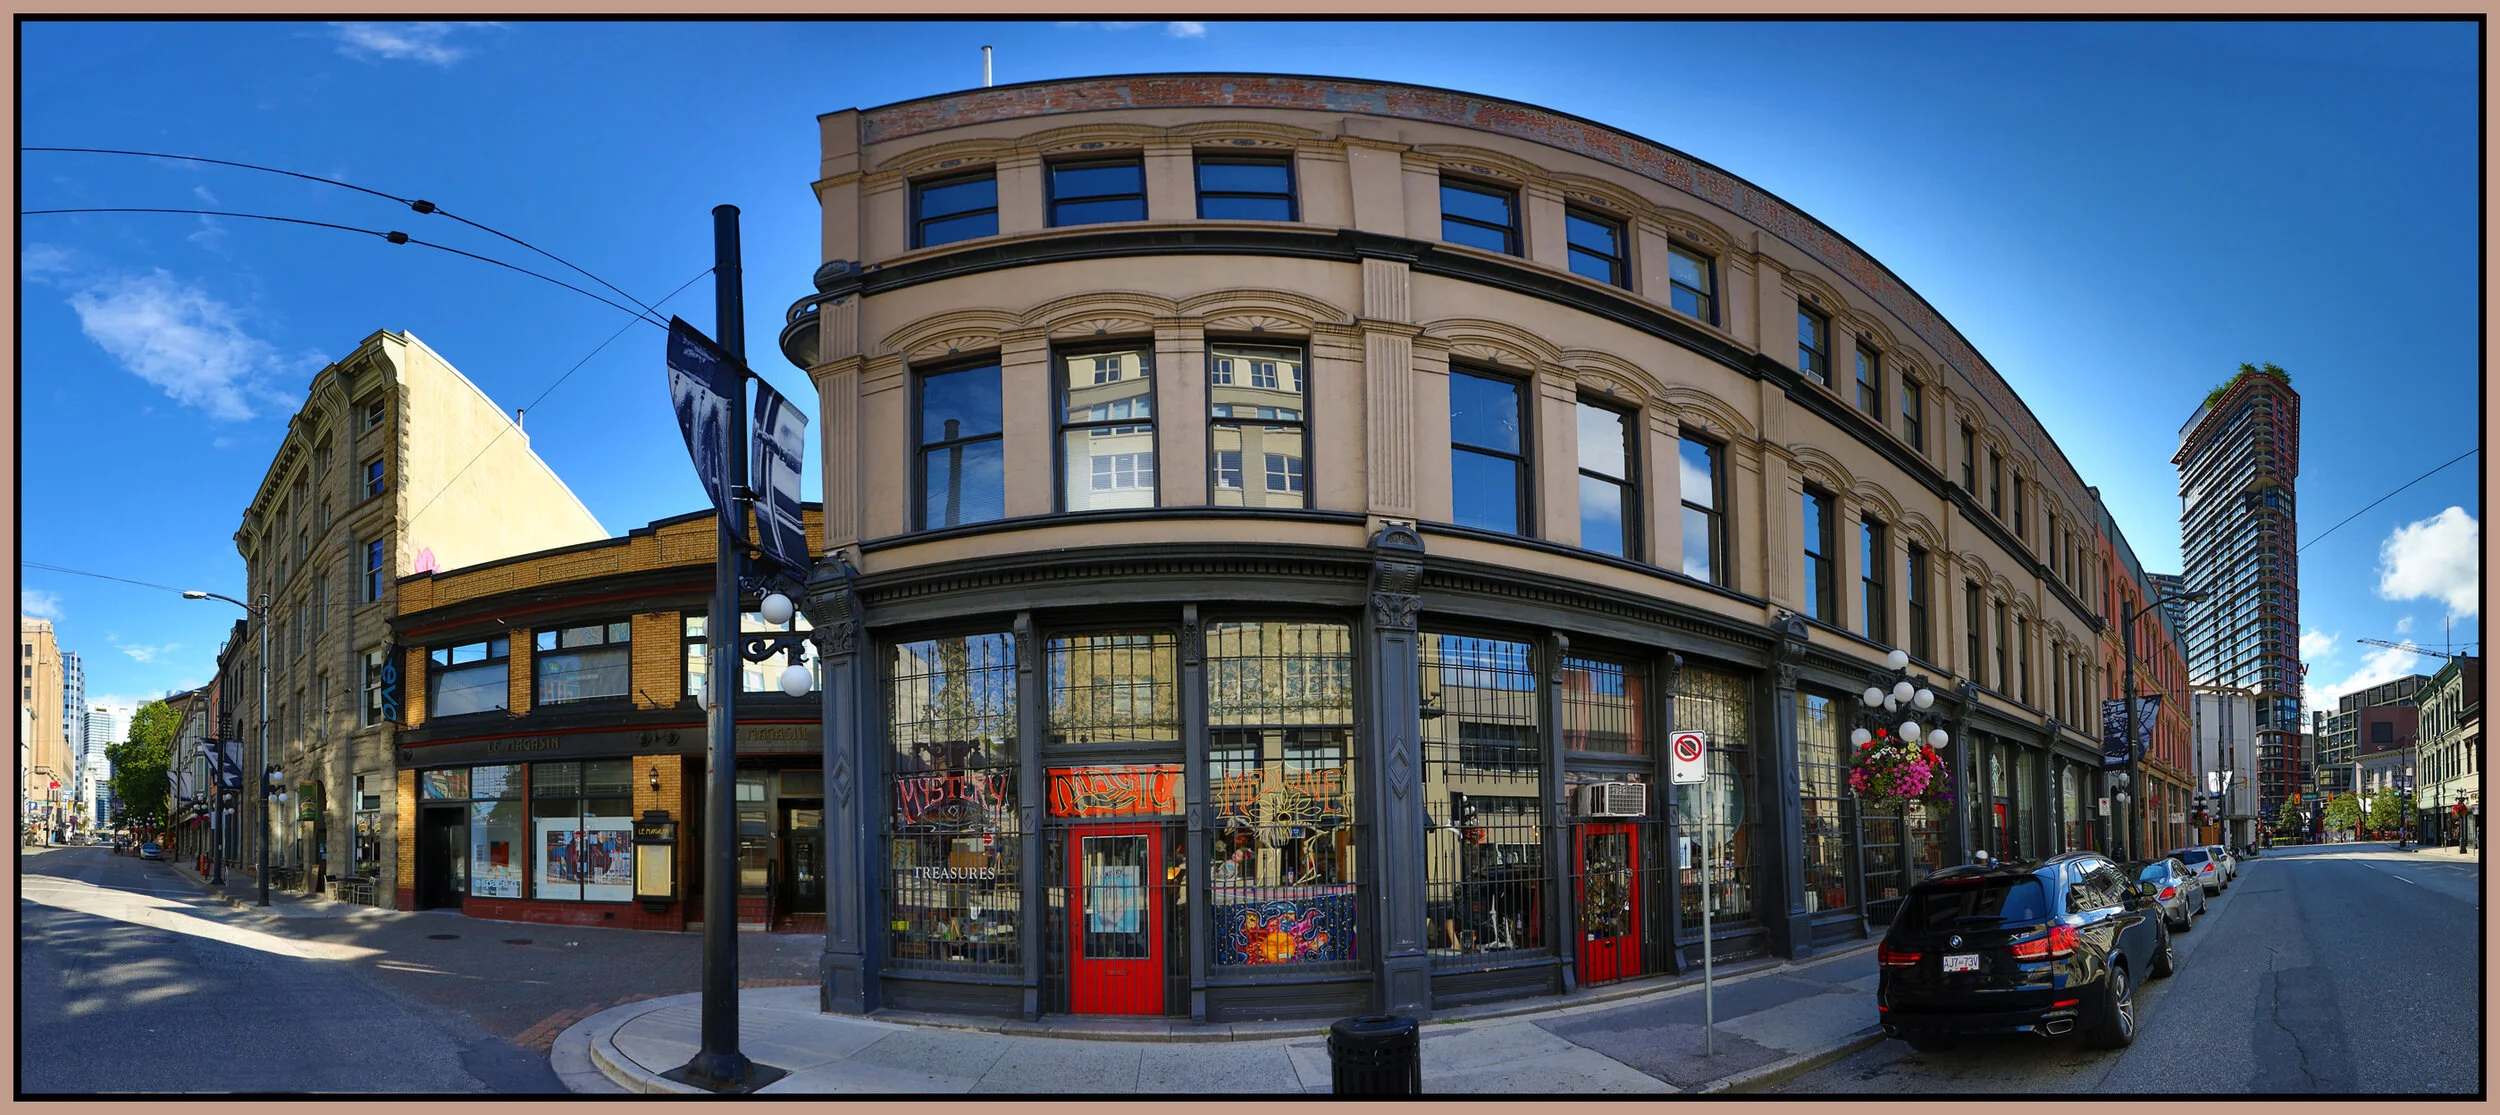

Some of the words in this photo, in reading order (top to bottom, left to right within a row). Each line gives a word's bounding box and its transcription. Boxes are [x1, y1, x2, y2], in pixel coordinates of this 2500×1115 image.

[381, 657, 399, 721] evo
[487, 741, 500, 753] LE
[506, 737, 559, 752] MAGASIN
[746, 727, 808, 741] MAGASIN
[898, 774, 1007, 825] MYSTERY
[1055, 769, 1171, 813] MAGIC
[1222, 769, 1342, 815] MEDICINE
[914, 866, 995, 880] TREASURES
[2009, 932, 2030, 940] X5
